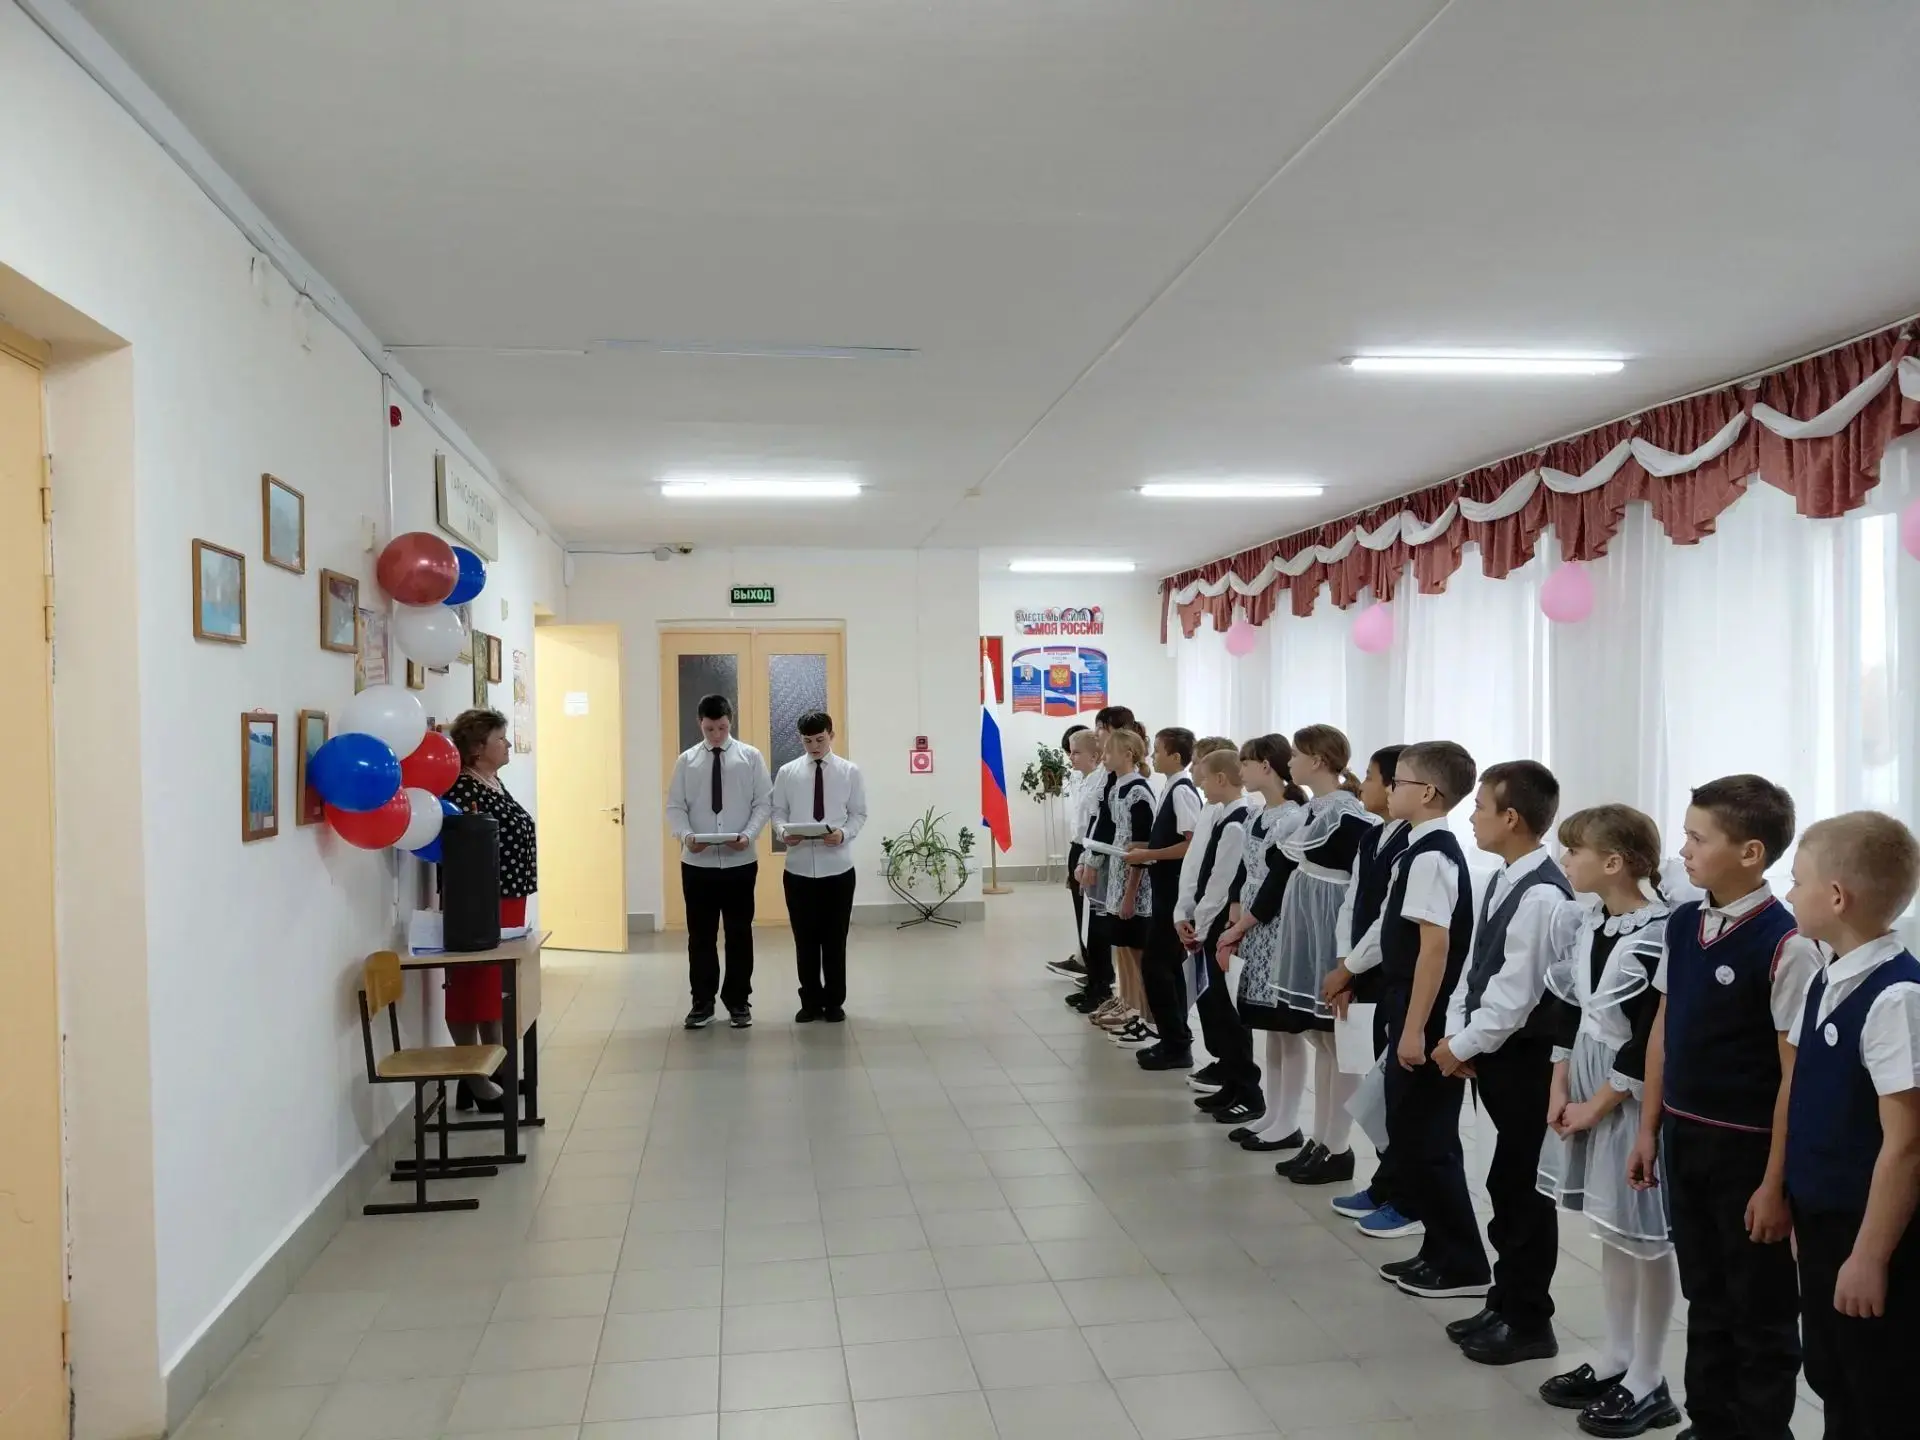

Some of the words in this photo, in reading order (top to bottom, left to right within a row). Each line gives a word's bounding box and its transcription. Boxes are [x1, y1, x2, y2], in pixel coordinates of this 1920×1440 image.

[733, 589, 772, 601] ВЫХОД
[1015, 612, 1046, 621] ВМЕСТЕ
[1036, 623, 1057, 635] МОЯ
[1061, 623, 1104, 635] РОССИЯ!
